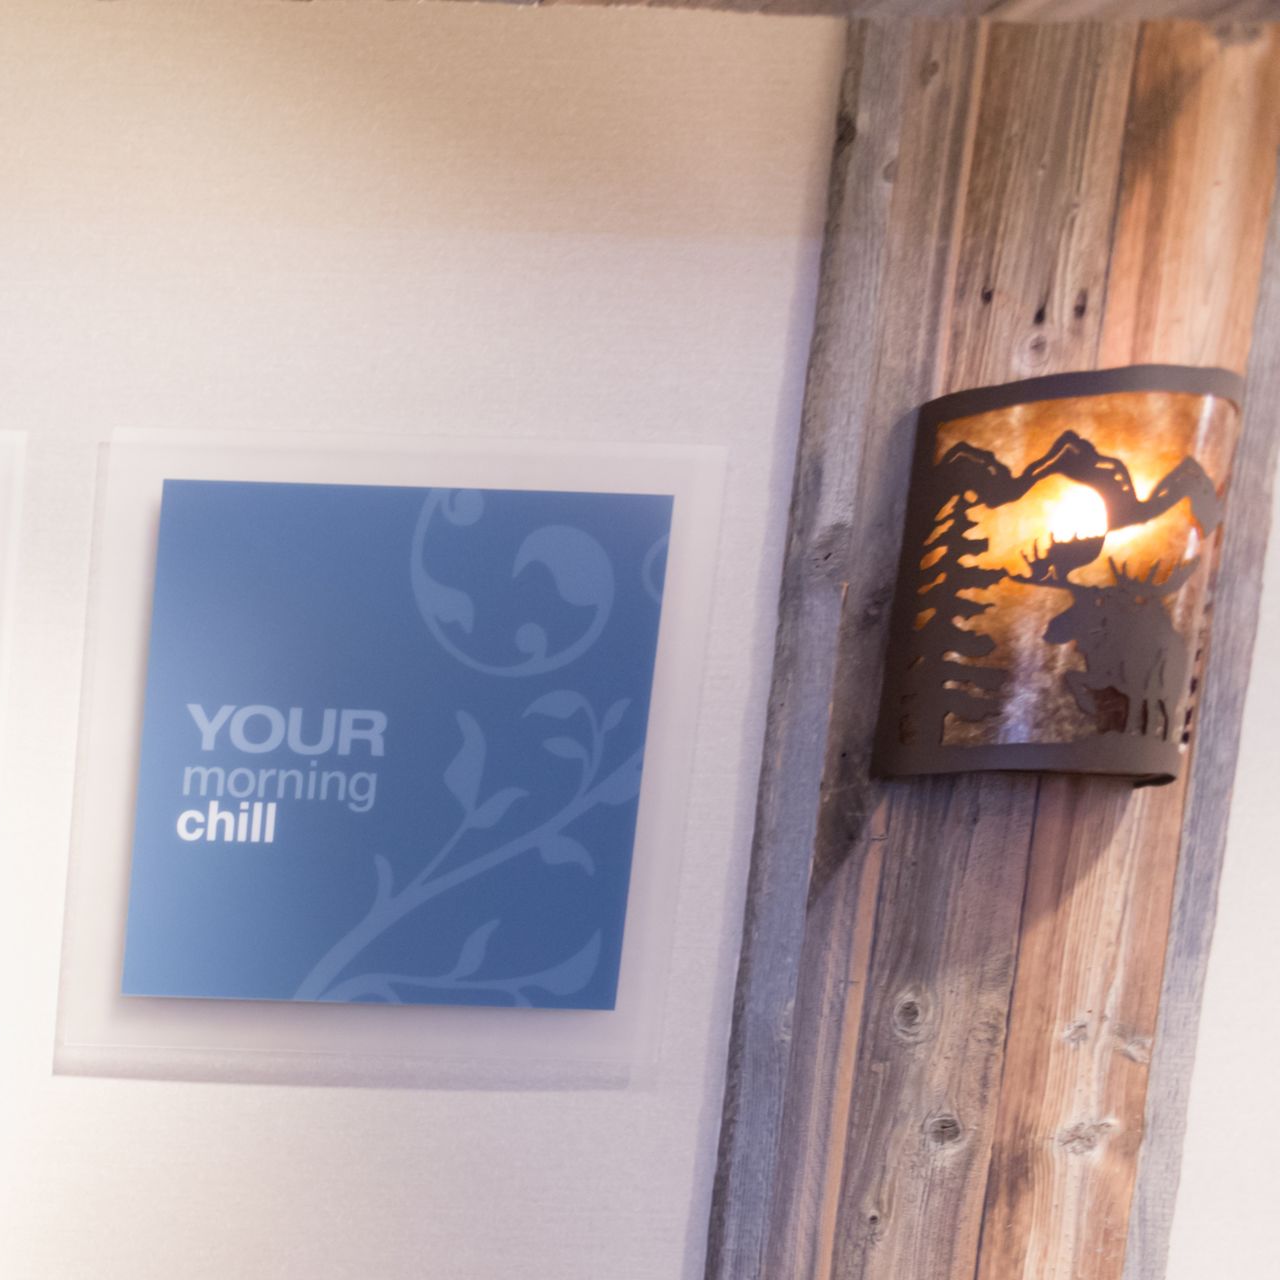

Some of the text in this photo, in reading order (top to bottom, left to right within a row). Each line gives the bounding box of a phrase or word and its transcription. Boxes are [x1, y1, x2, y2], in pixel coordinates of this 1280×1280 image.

[186, 704, 388, 756] YOUR
[182, 760, 377, 812] morning
[176, 800, 276, 843] chill
